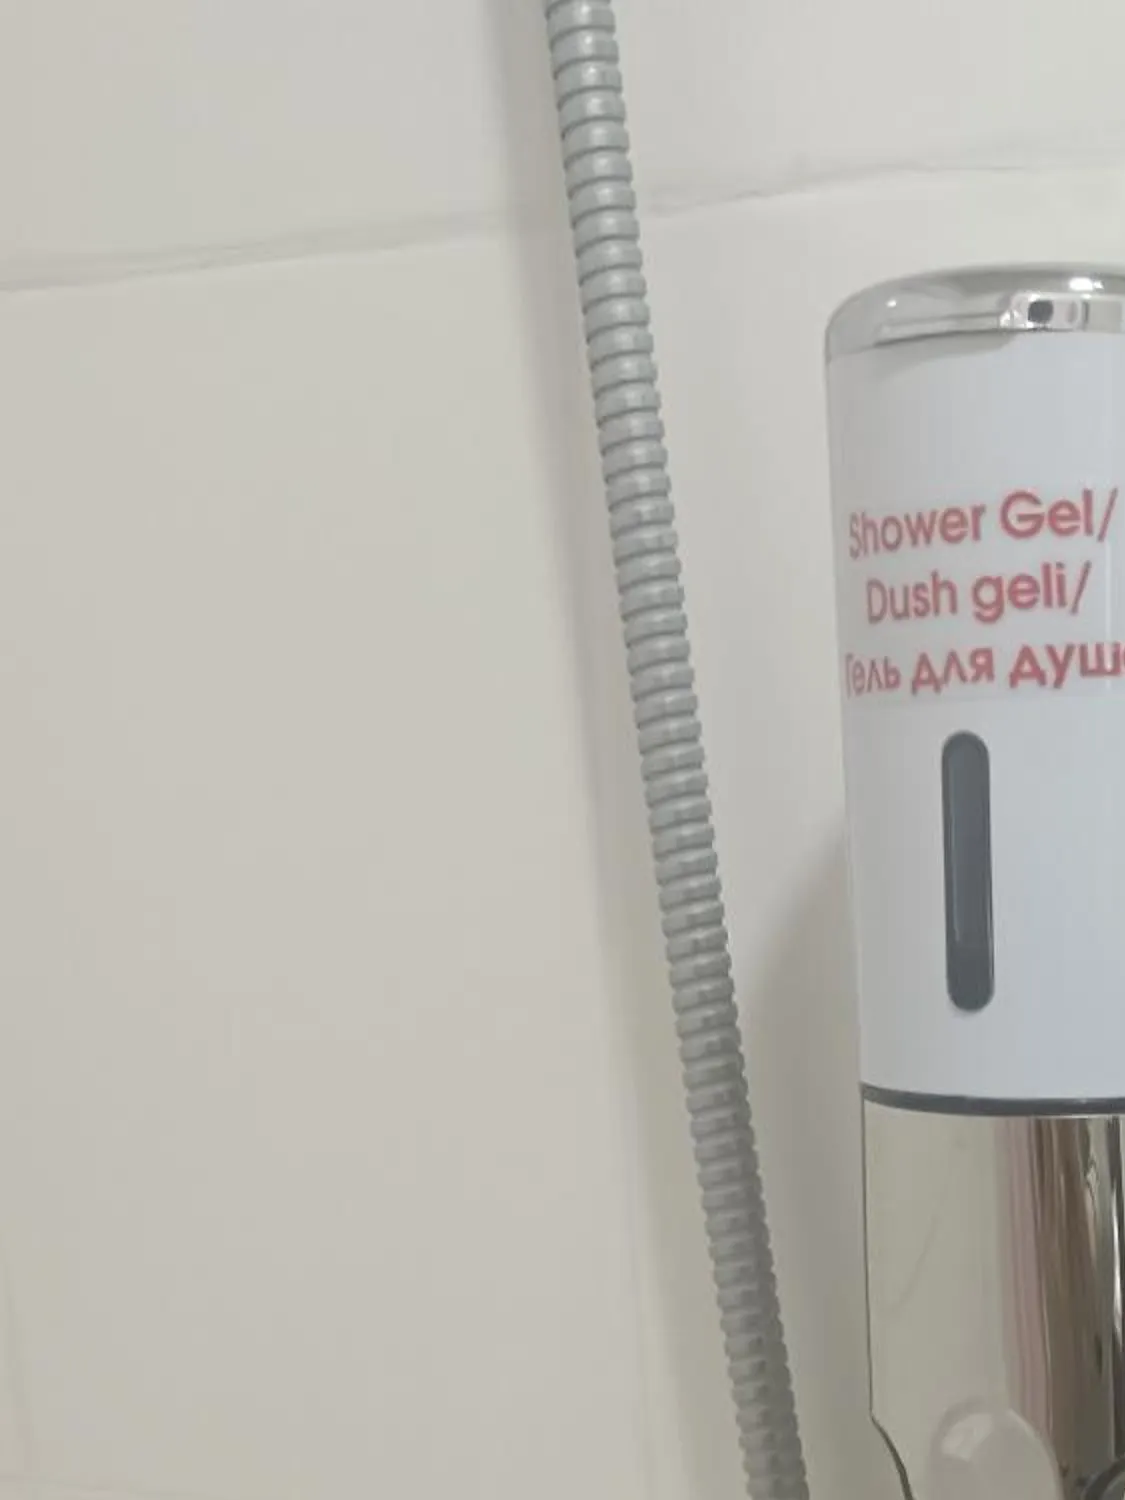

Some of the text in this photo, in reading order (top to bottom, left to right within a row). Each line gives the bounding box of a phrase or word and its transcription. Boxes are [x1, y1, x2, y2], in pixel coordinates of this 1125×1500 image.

[848, 488, 1118, 559] Shower Gel/
[866, 561, 1092, 624] Dush geli/
[845, 653, 901, 699] Гель
[911, 647, 996, 696] для
